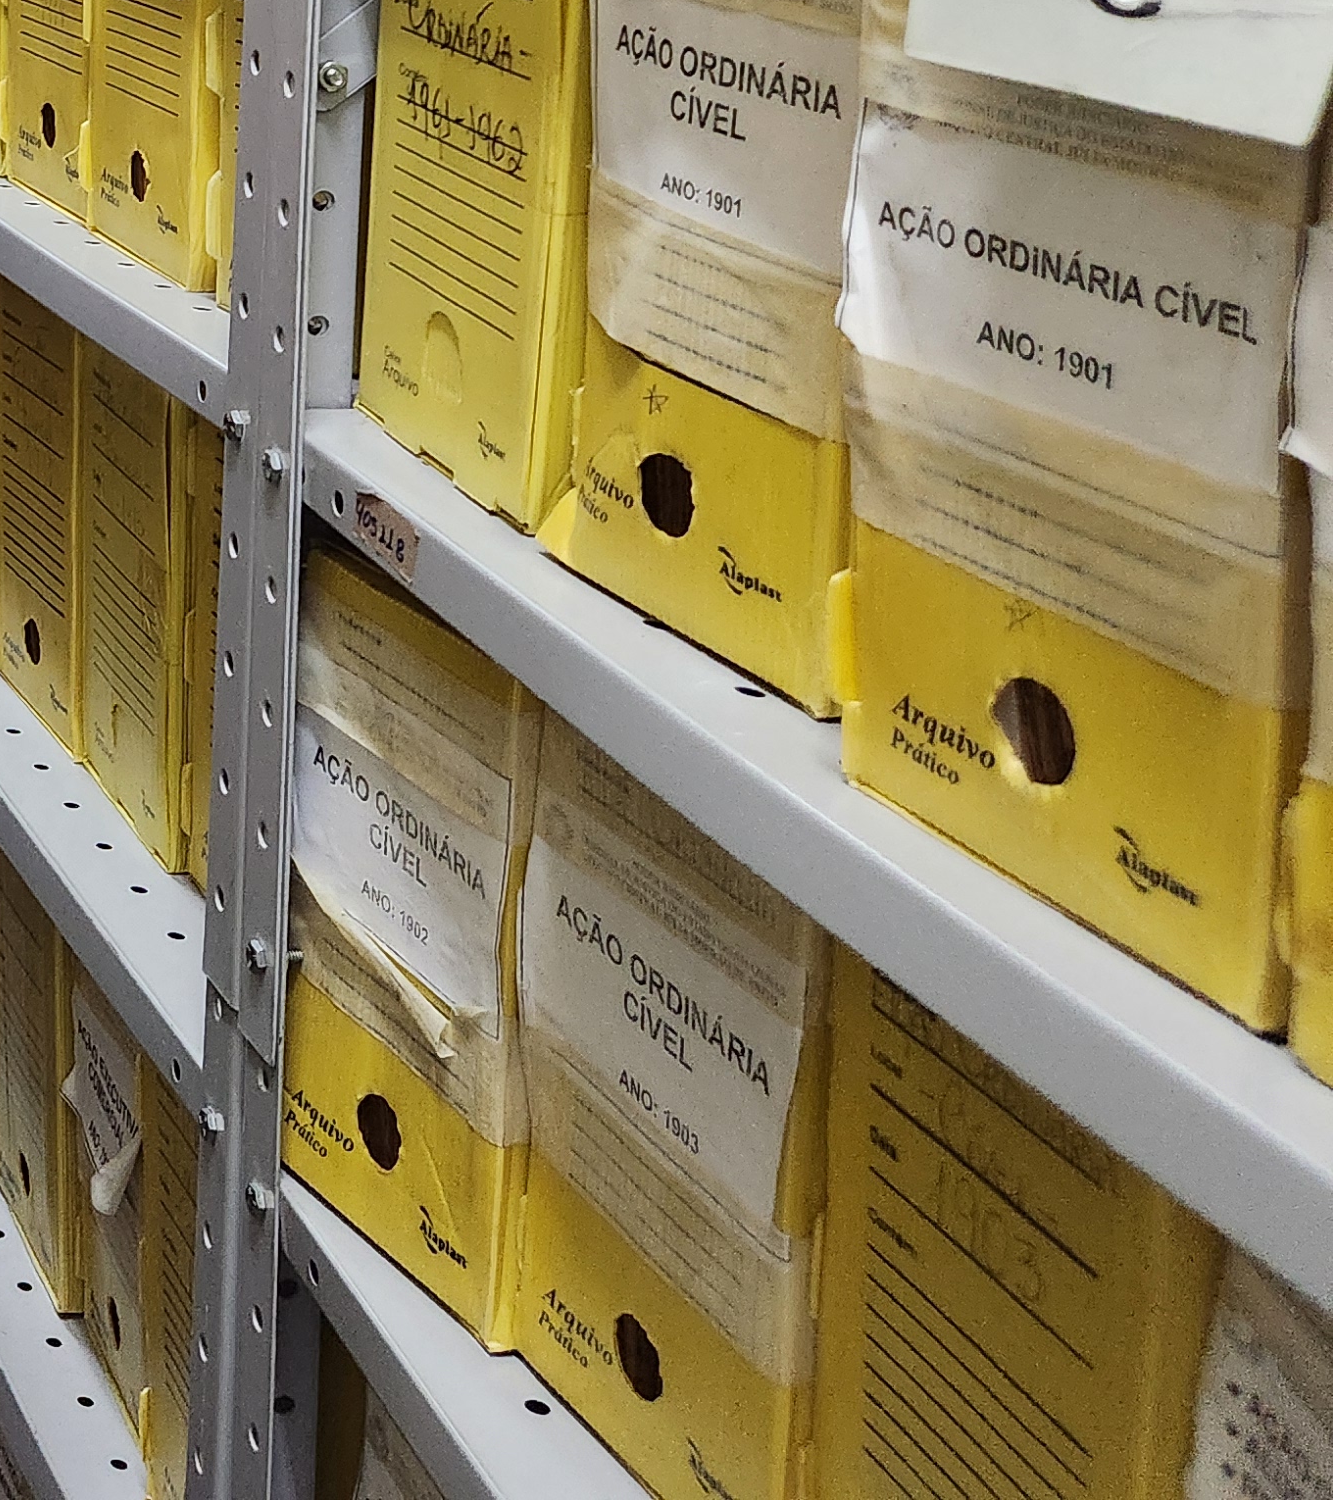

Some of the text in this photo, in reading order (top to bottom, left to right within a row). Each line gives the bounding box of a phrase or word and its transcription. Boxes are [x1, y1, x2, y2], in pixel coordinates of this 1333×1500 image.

[617, 23, 842, 120] AÇÃO ORDINÁRIA
[669, 89, 747, 142] CÍVEL
[101, 166, 129, 195] Arquivo
[661, 173, 743, 219] ANO: 1901
[879, 202, 1259, 346] AÇÃO ORDINÁRIA CÍVEL
[383, 360, 419, 397] Arquivo
[976, 321, 1114, 390] ANO: 1901
[719, 561, 783, 603] Alaplast
[889, 728, 962, 788] Prático
[891, 694, 997, 770] Arquivo
[313, 744, 487, 900] AÇÃO ORDINÁRIA
[369, 823, 428, 889] CÍVEL
[1116, 847, 1202, 908] Alaplast
[361, 879, 430, 946] ANO: 1902
[557, 895, 623, 966] AÇÃO
[630, 952, 771, 1096] ORDINÁRIA
[622, 990, 693, 1072] CÍVEL
[284, 1108, 328, 1158] Prático
[291, 1089, 355, 1153] Arquivo
[619, 1069, 701, 1153] ANO: 1903
[420, 1219, 468, 1269] Alaplast
[538, 1310, 588, 1368] Prático
[541, 1288, 613, 1366] Arquivo
